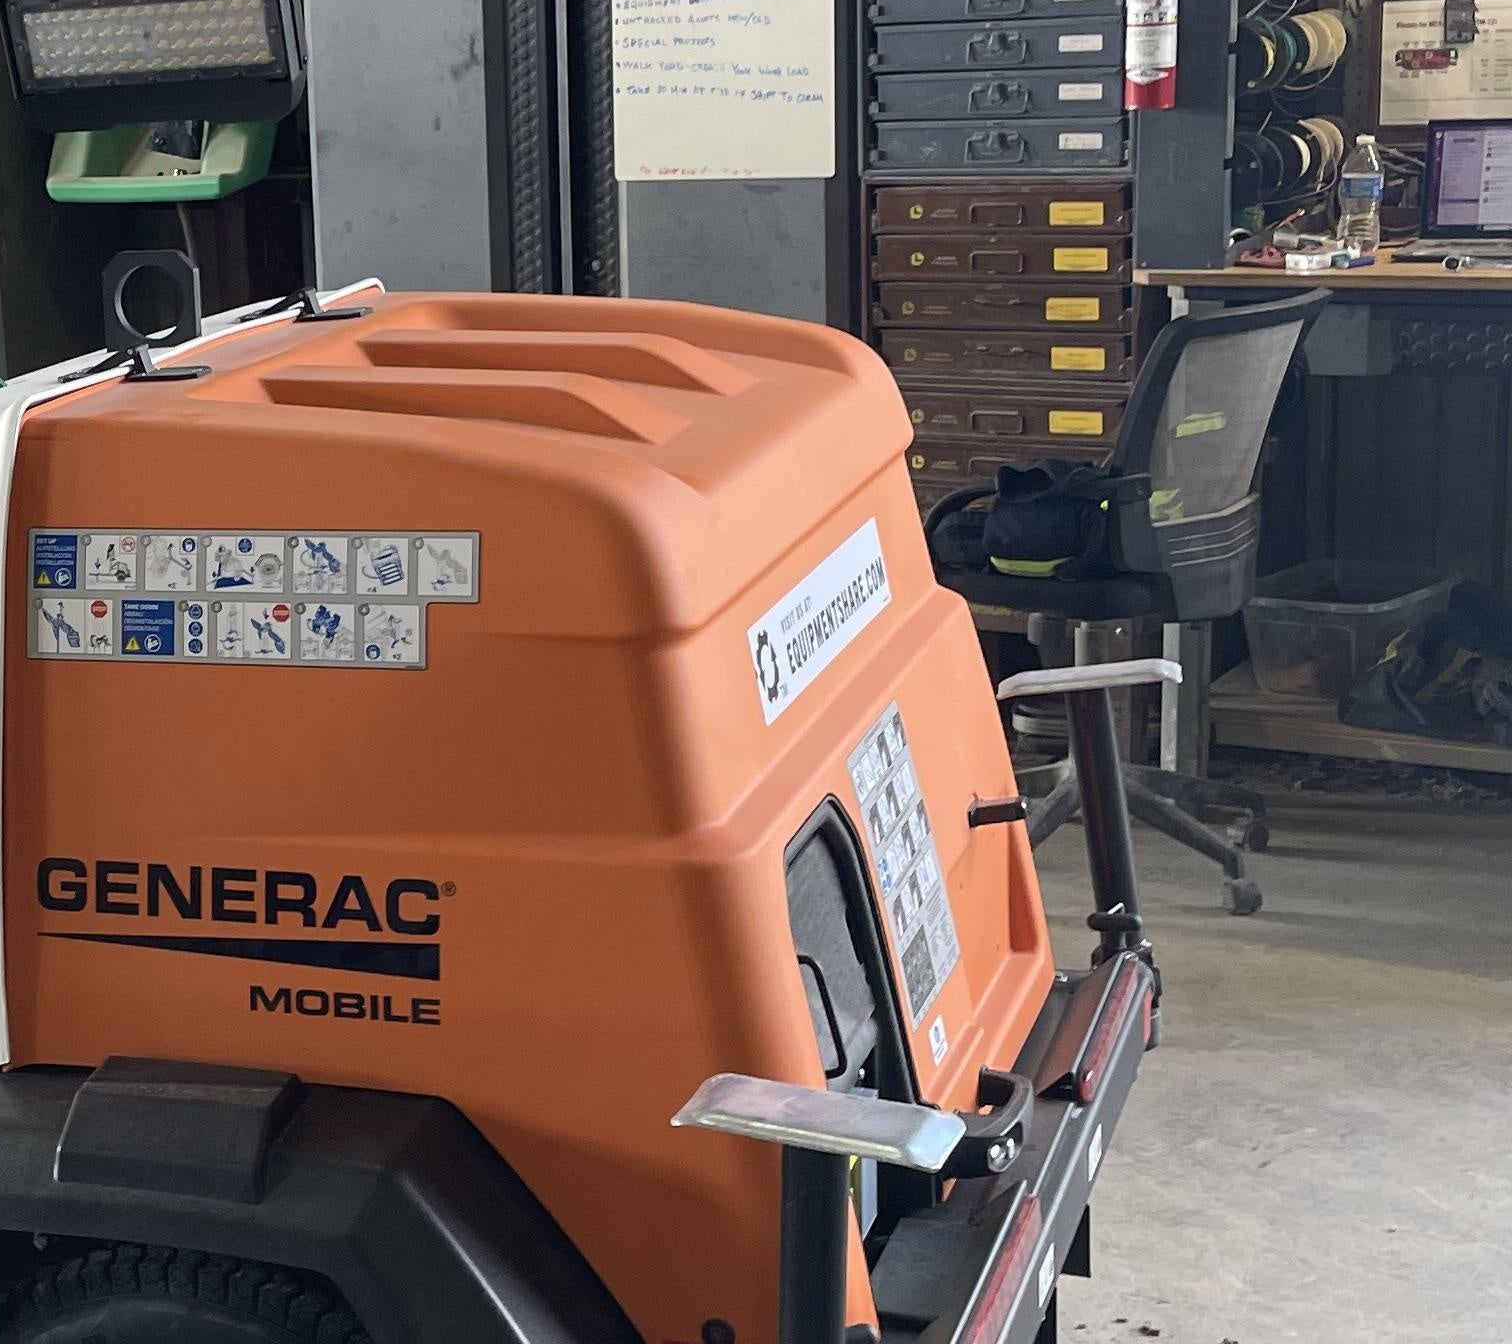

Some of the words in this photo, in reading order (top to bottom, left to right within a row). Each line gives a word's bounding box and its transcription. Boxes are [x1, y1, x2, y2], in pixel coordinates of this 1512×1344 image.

[786, 555, 886, 675] EQUIPMENTSHARE.COM
[36, 856, 441, 937] GENERAC
[249, 984, 442, 1027] MOBILE
